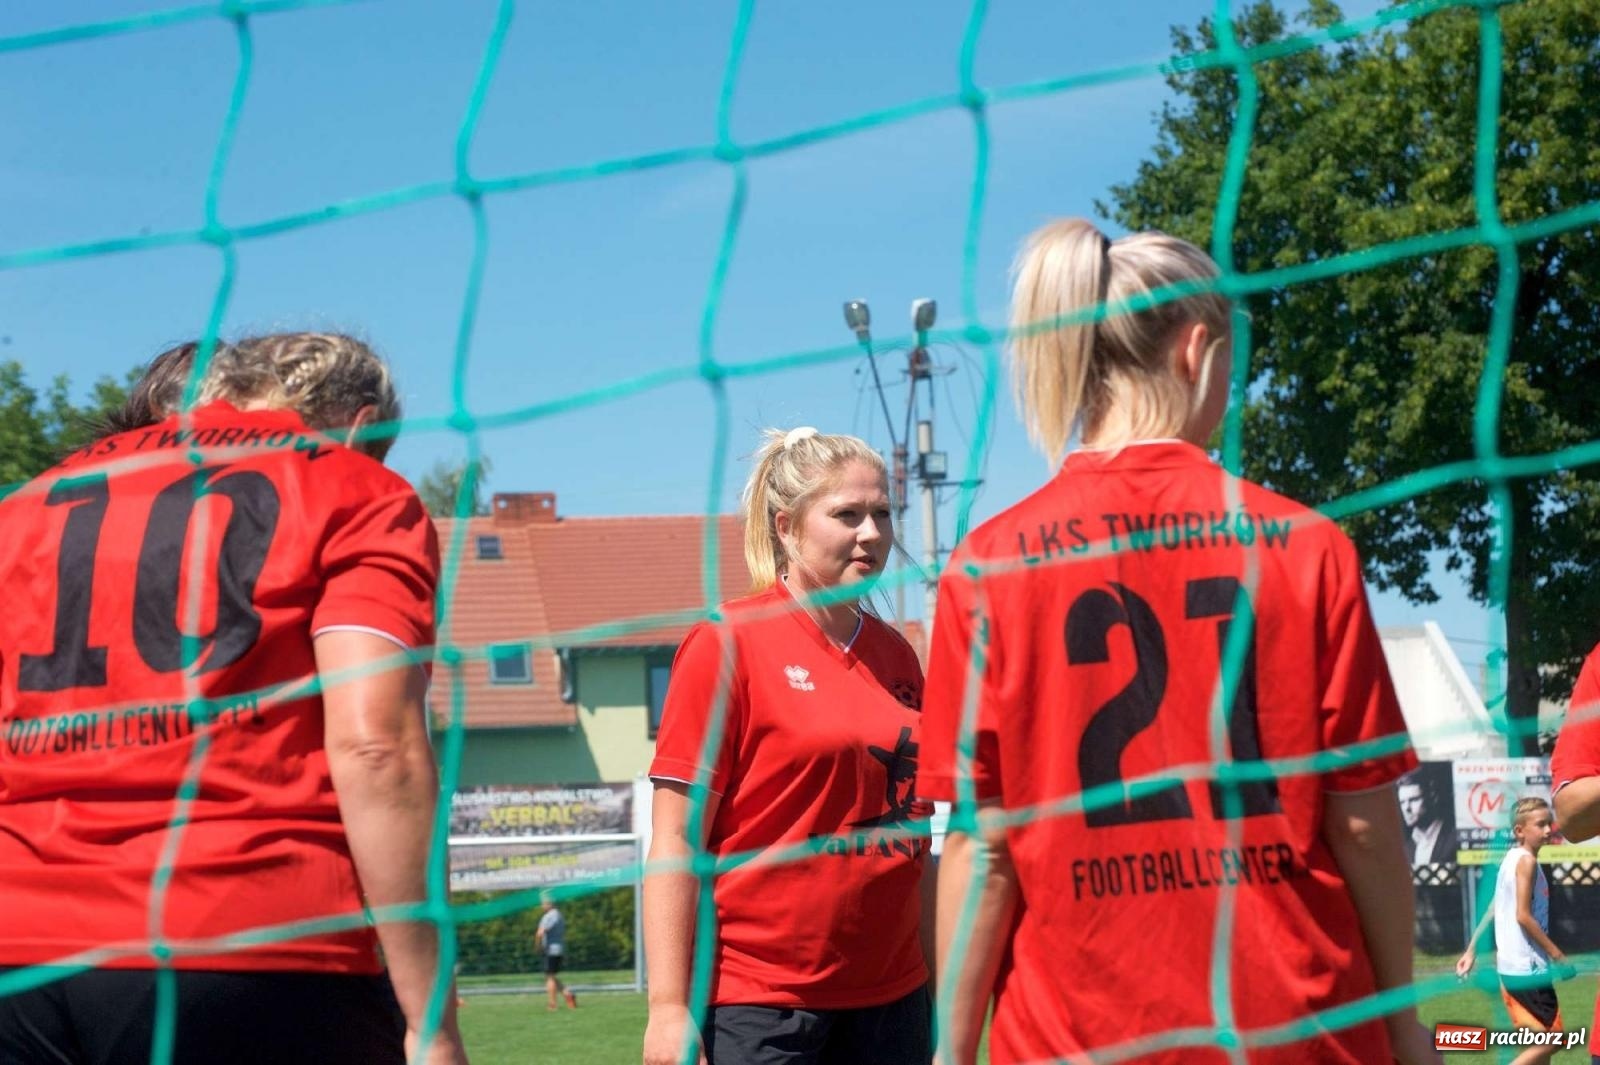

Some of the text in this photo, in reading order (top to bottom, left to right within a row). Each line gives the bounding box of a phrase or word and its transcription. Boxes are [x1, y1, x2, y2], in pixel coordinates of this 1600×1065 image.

[17, 463, 281, 692] 10
[1017, 503, 1293, 564] LKS TWORKÓW
